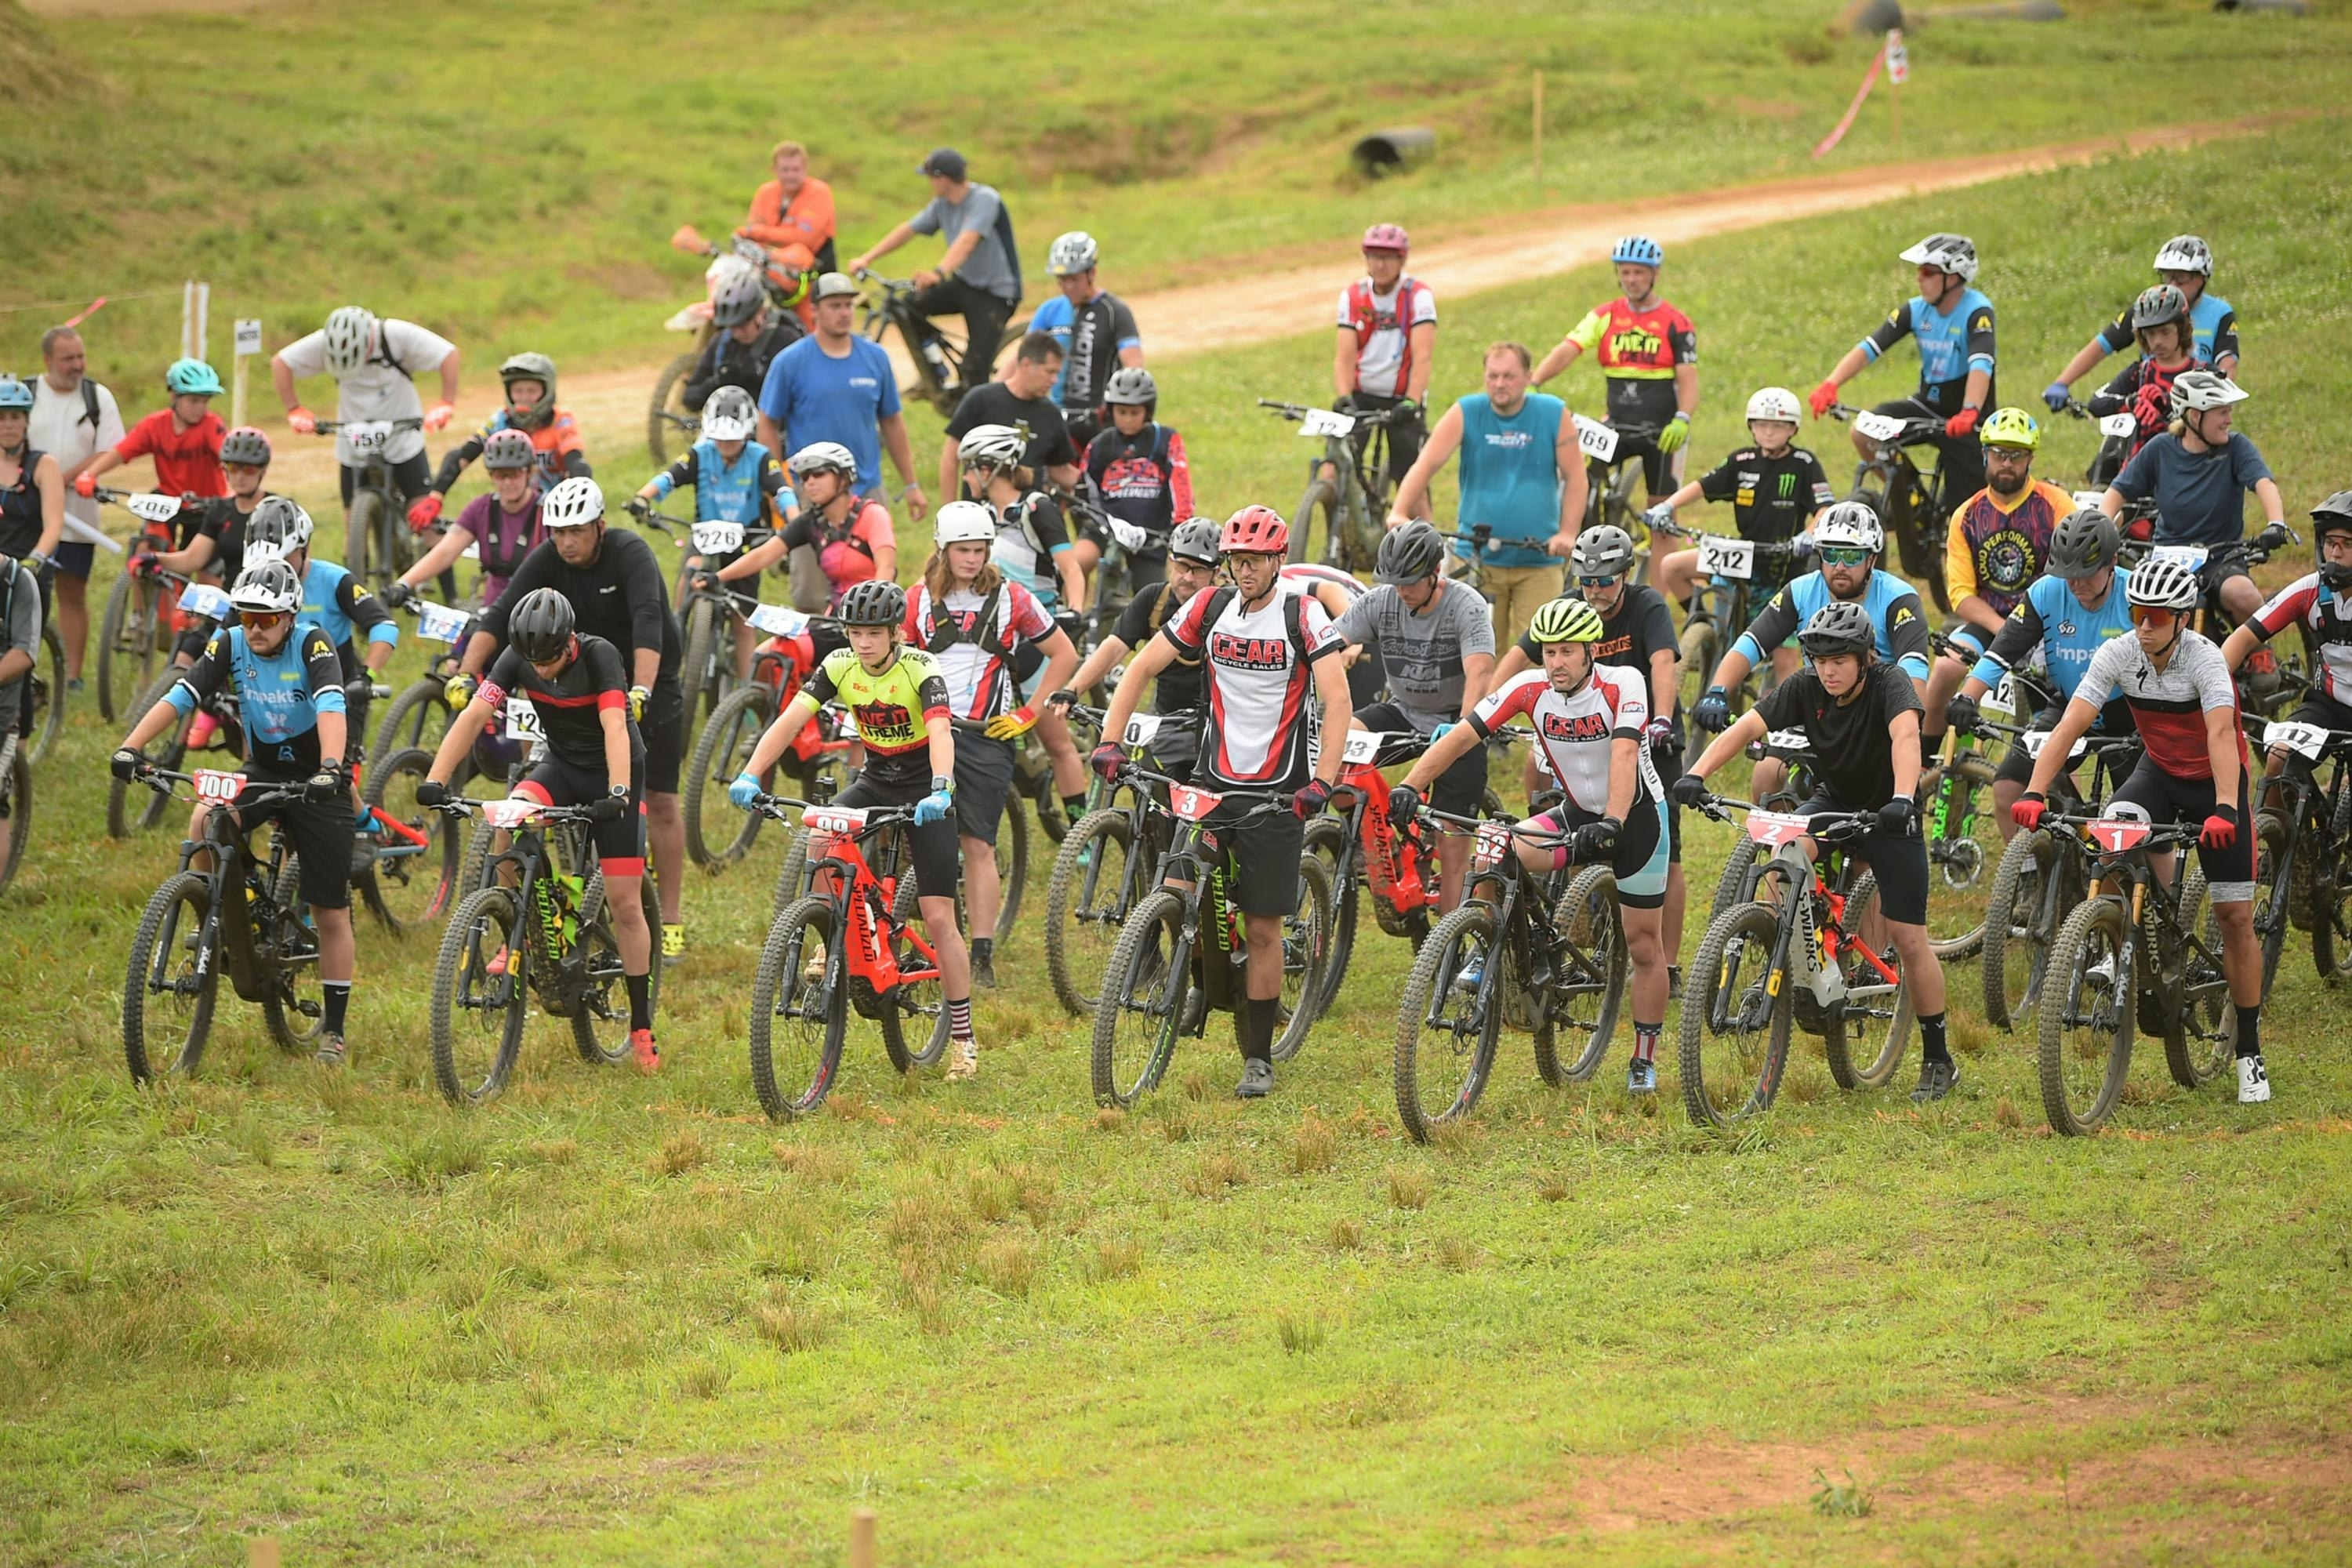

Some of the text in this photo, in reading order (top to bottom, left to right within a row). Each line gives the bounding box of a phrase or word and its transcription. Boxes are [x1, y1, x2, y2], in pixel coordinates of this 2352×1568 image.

[1067, 320, 1096, 401] MOTION
[700, 530, 735, 548] 226
[1706, 548, 1744, 570] 212
[1984, 530, 2035, 576] PERFORMANCE
[1213, 633, 1284, 664] GEAR
[1214, 656, 1250, 669] BICYCLE
[1399, 663, 1441, 680] KTM
[243, 685, 294, 705] impakt
[856, 708, 909, 726] LIVE IT
[1545, 714, 1605, 738] GEAR
[860, 723, 915, 739] XTREME
[1547, 733, 1579, 742] BICYCLE
[198, 775, 237, 800] 100
[1181, 792, 1199, 815] 3
[1762, 824, 1783, 840] 2
[2111, 829, 2124, 852] 1
[1475, 833, 1507, 859] 52
[534, 877, 560, 960] SPECIALIZED
[1210, 866, 1230, 951] SPECIALIZED
[853, 882, 873, 962] SPECIALIZED
[1799, 891, 1817, 973] S-WORKS
[198, 946, 212, 975] FOX
